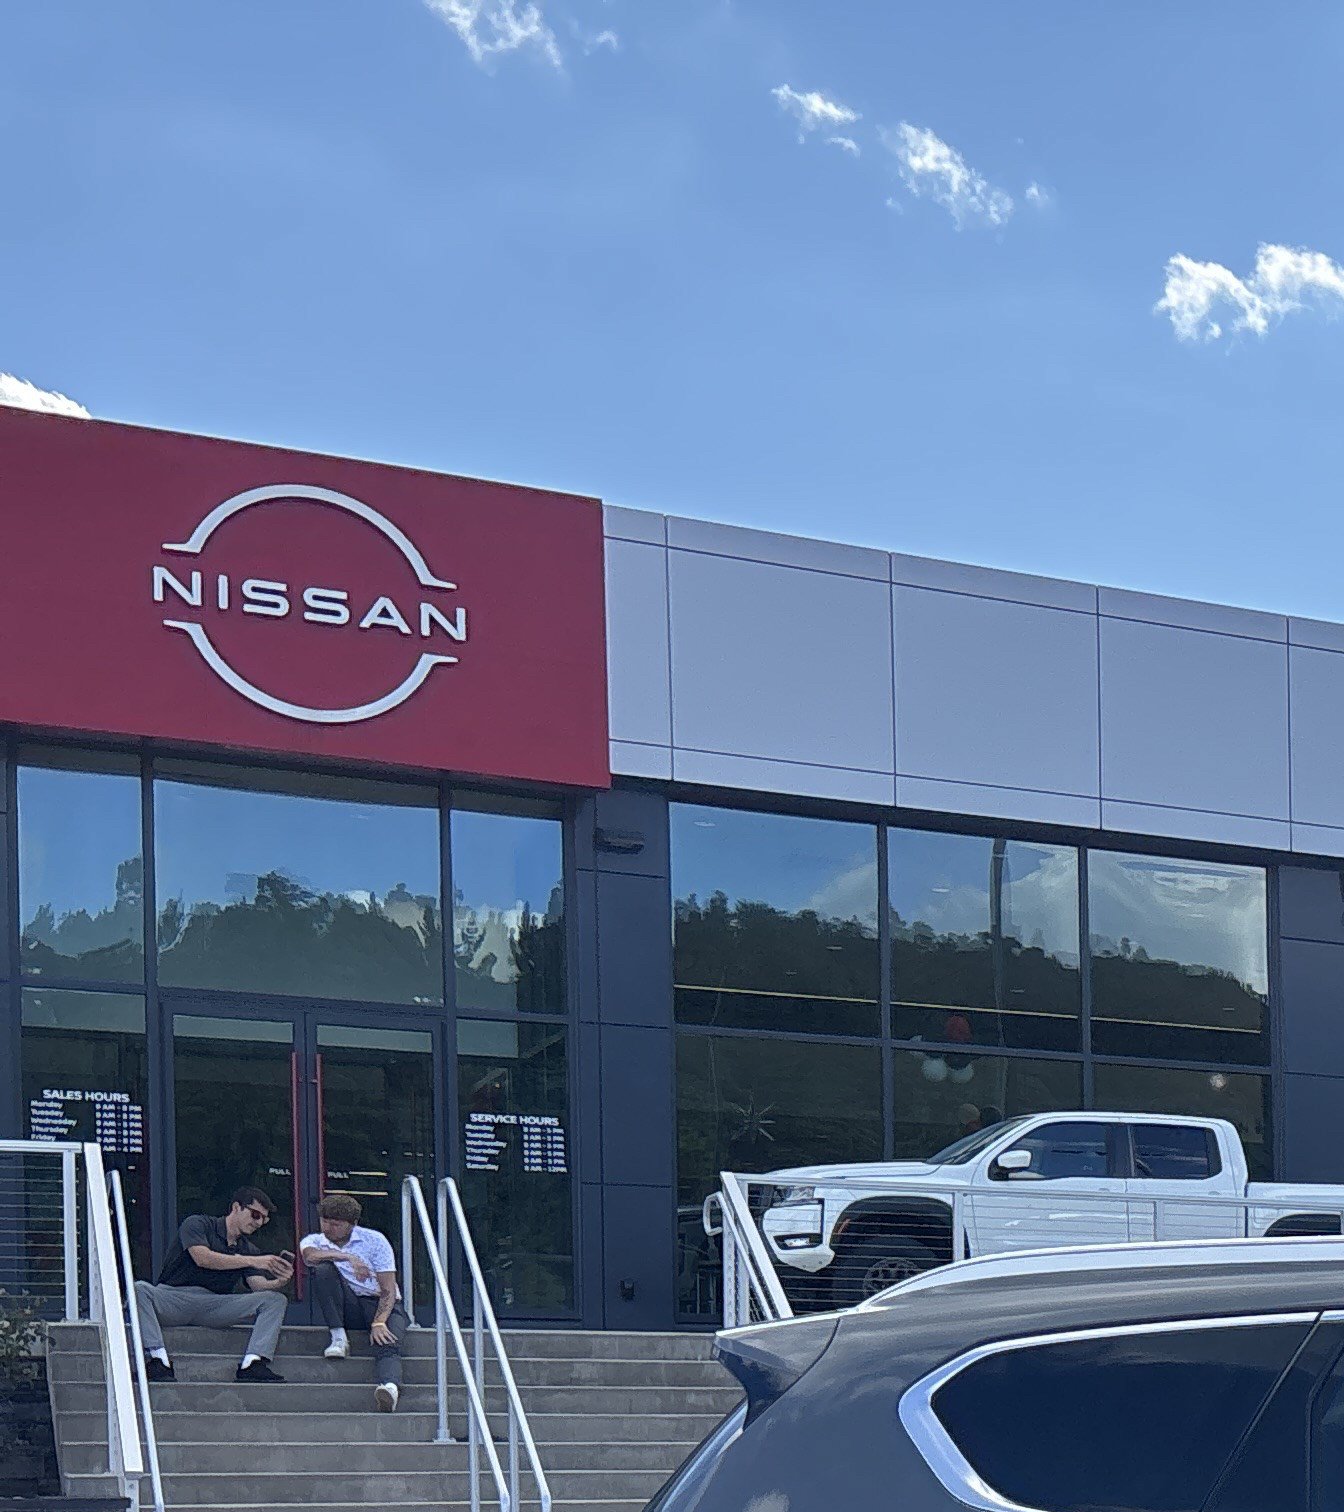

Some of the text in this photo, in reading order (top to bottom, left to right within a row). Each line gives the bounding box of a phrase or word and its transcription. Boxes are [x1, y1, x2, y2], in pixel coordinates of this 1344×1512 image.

[152, 565, 467, 642] NISSAN
[42, 1089, 130, 1103] SALES HOURS
[470, 1113, 559, 1126] SERVICE HOURS
